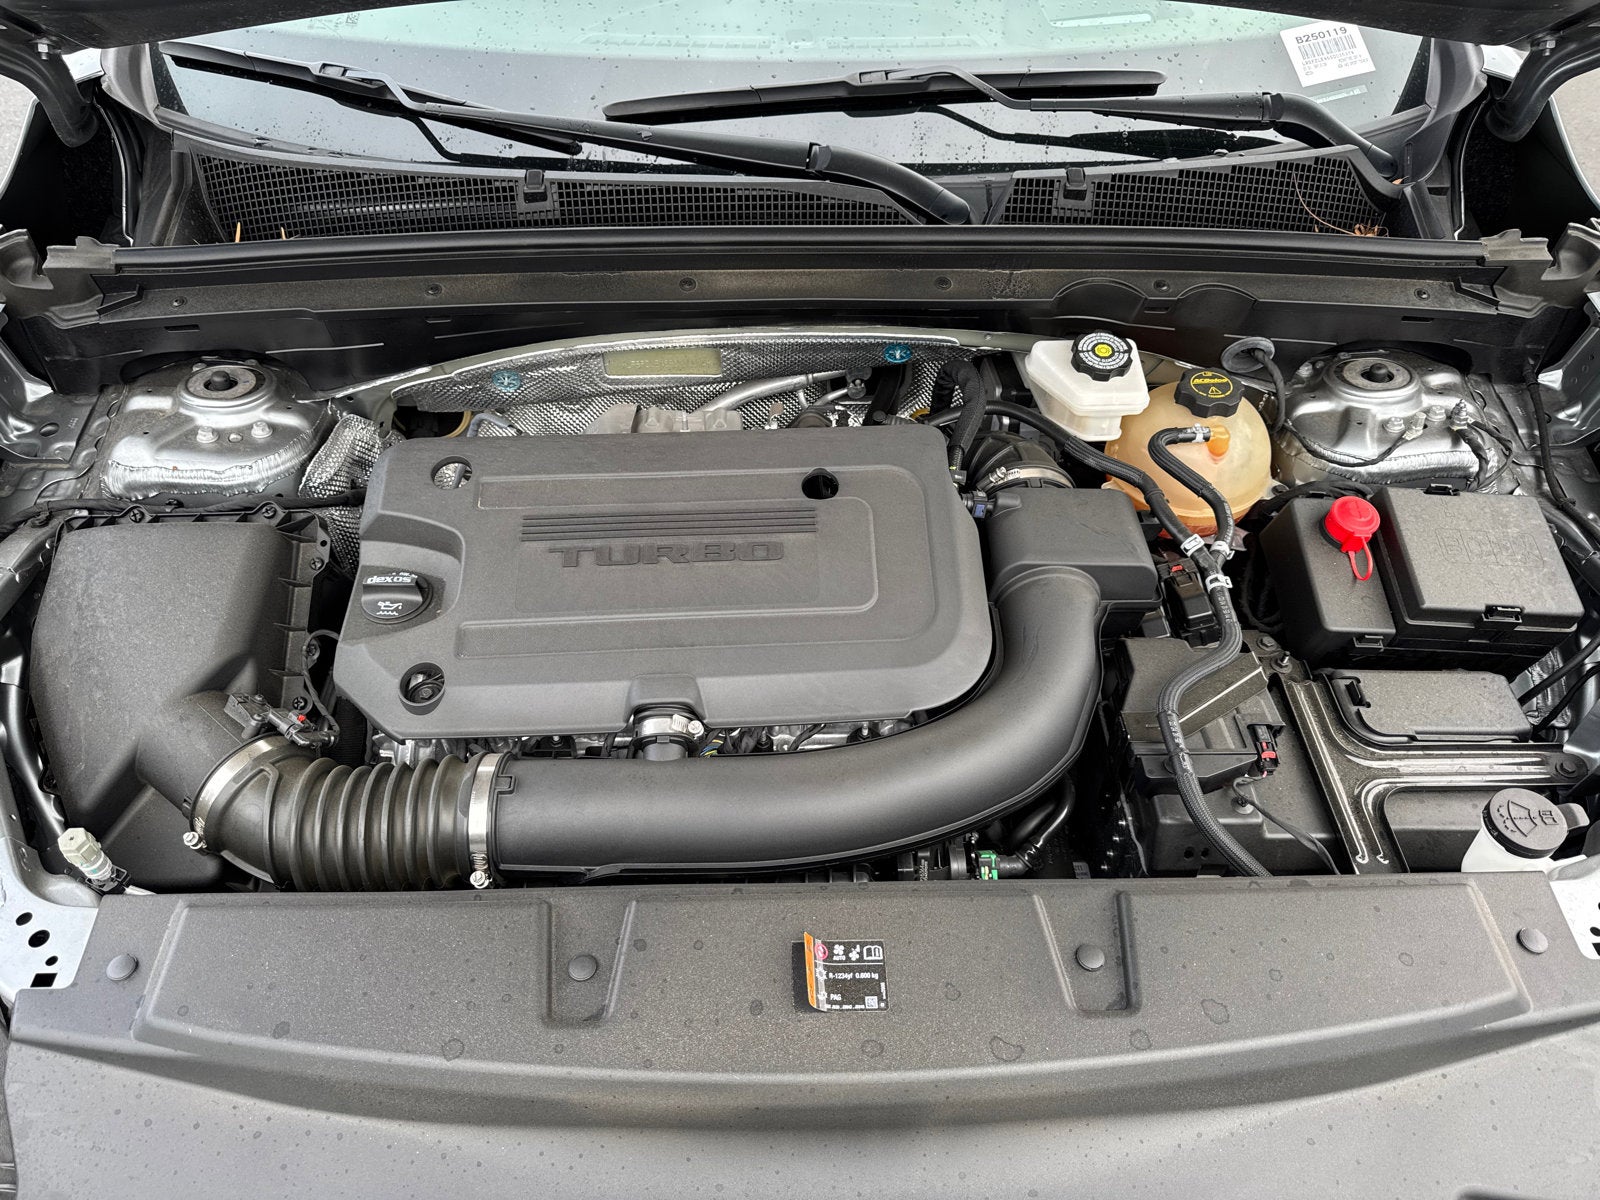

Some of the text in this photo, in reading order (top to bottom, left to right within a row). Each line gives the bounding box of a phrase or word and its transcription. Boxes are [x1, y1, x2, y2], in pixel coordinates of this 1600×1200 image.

[1295, 26, 1347, 45] B250119
[549, 541, 784, 567] TURBO
[366, 575, 412, 584] dexos
[828, 972, 853, 980] R-1234yf
[871, 972, 879, 980] kg
